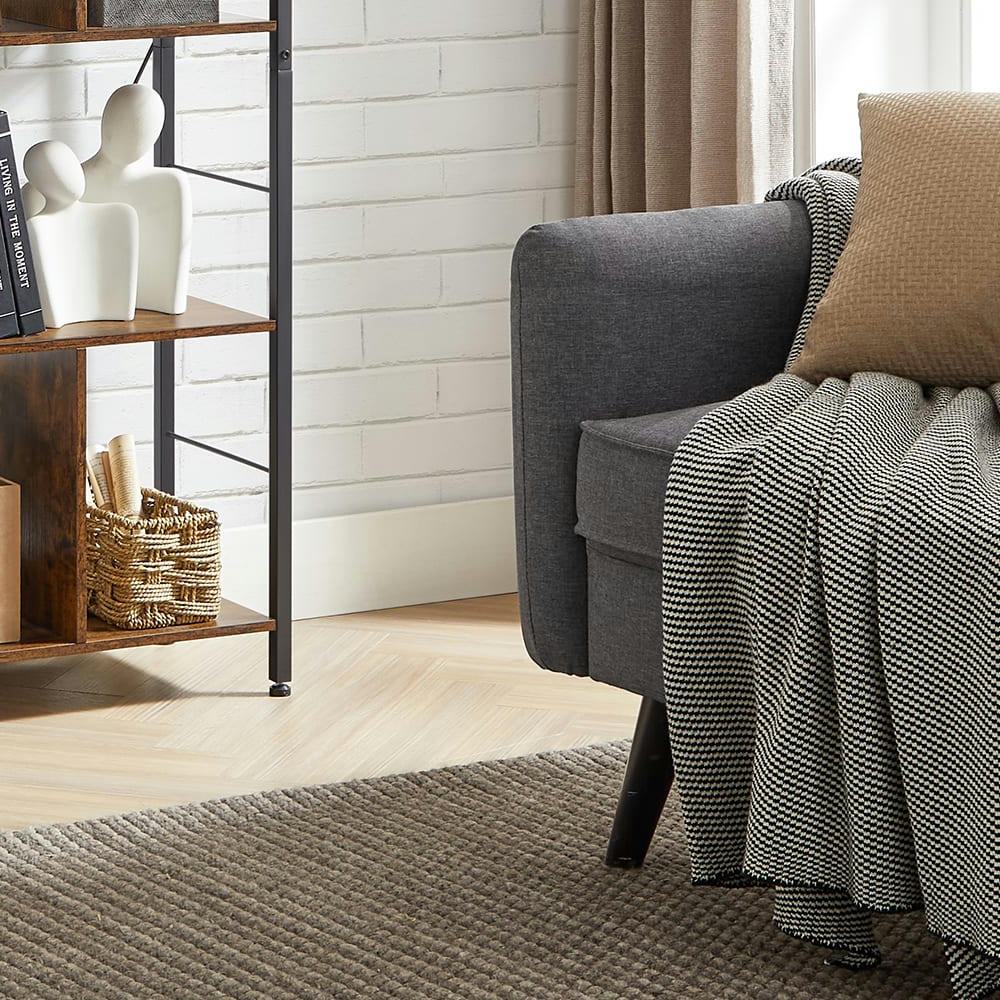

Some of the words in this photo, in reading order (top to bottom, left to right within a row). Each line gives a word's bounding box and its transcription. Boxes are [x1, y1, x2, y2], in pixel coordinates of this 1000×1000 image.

[0, 158, 14, 196] LIVING
[6, 199, 16, 212] IN
[9, 214, 21, 238] THE
[13, 241, 30, 288] MOMENT
